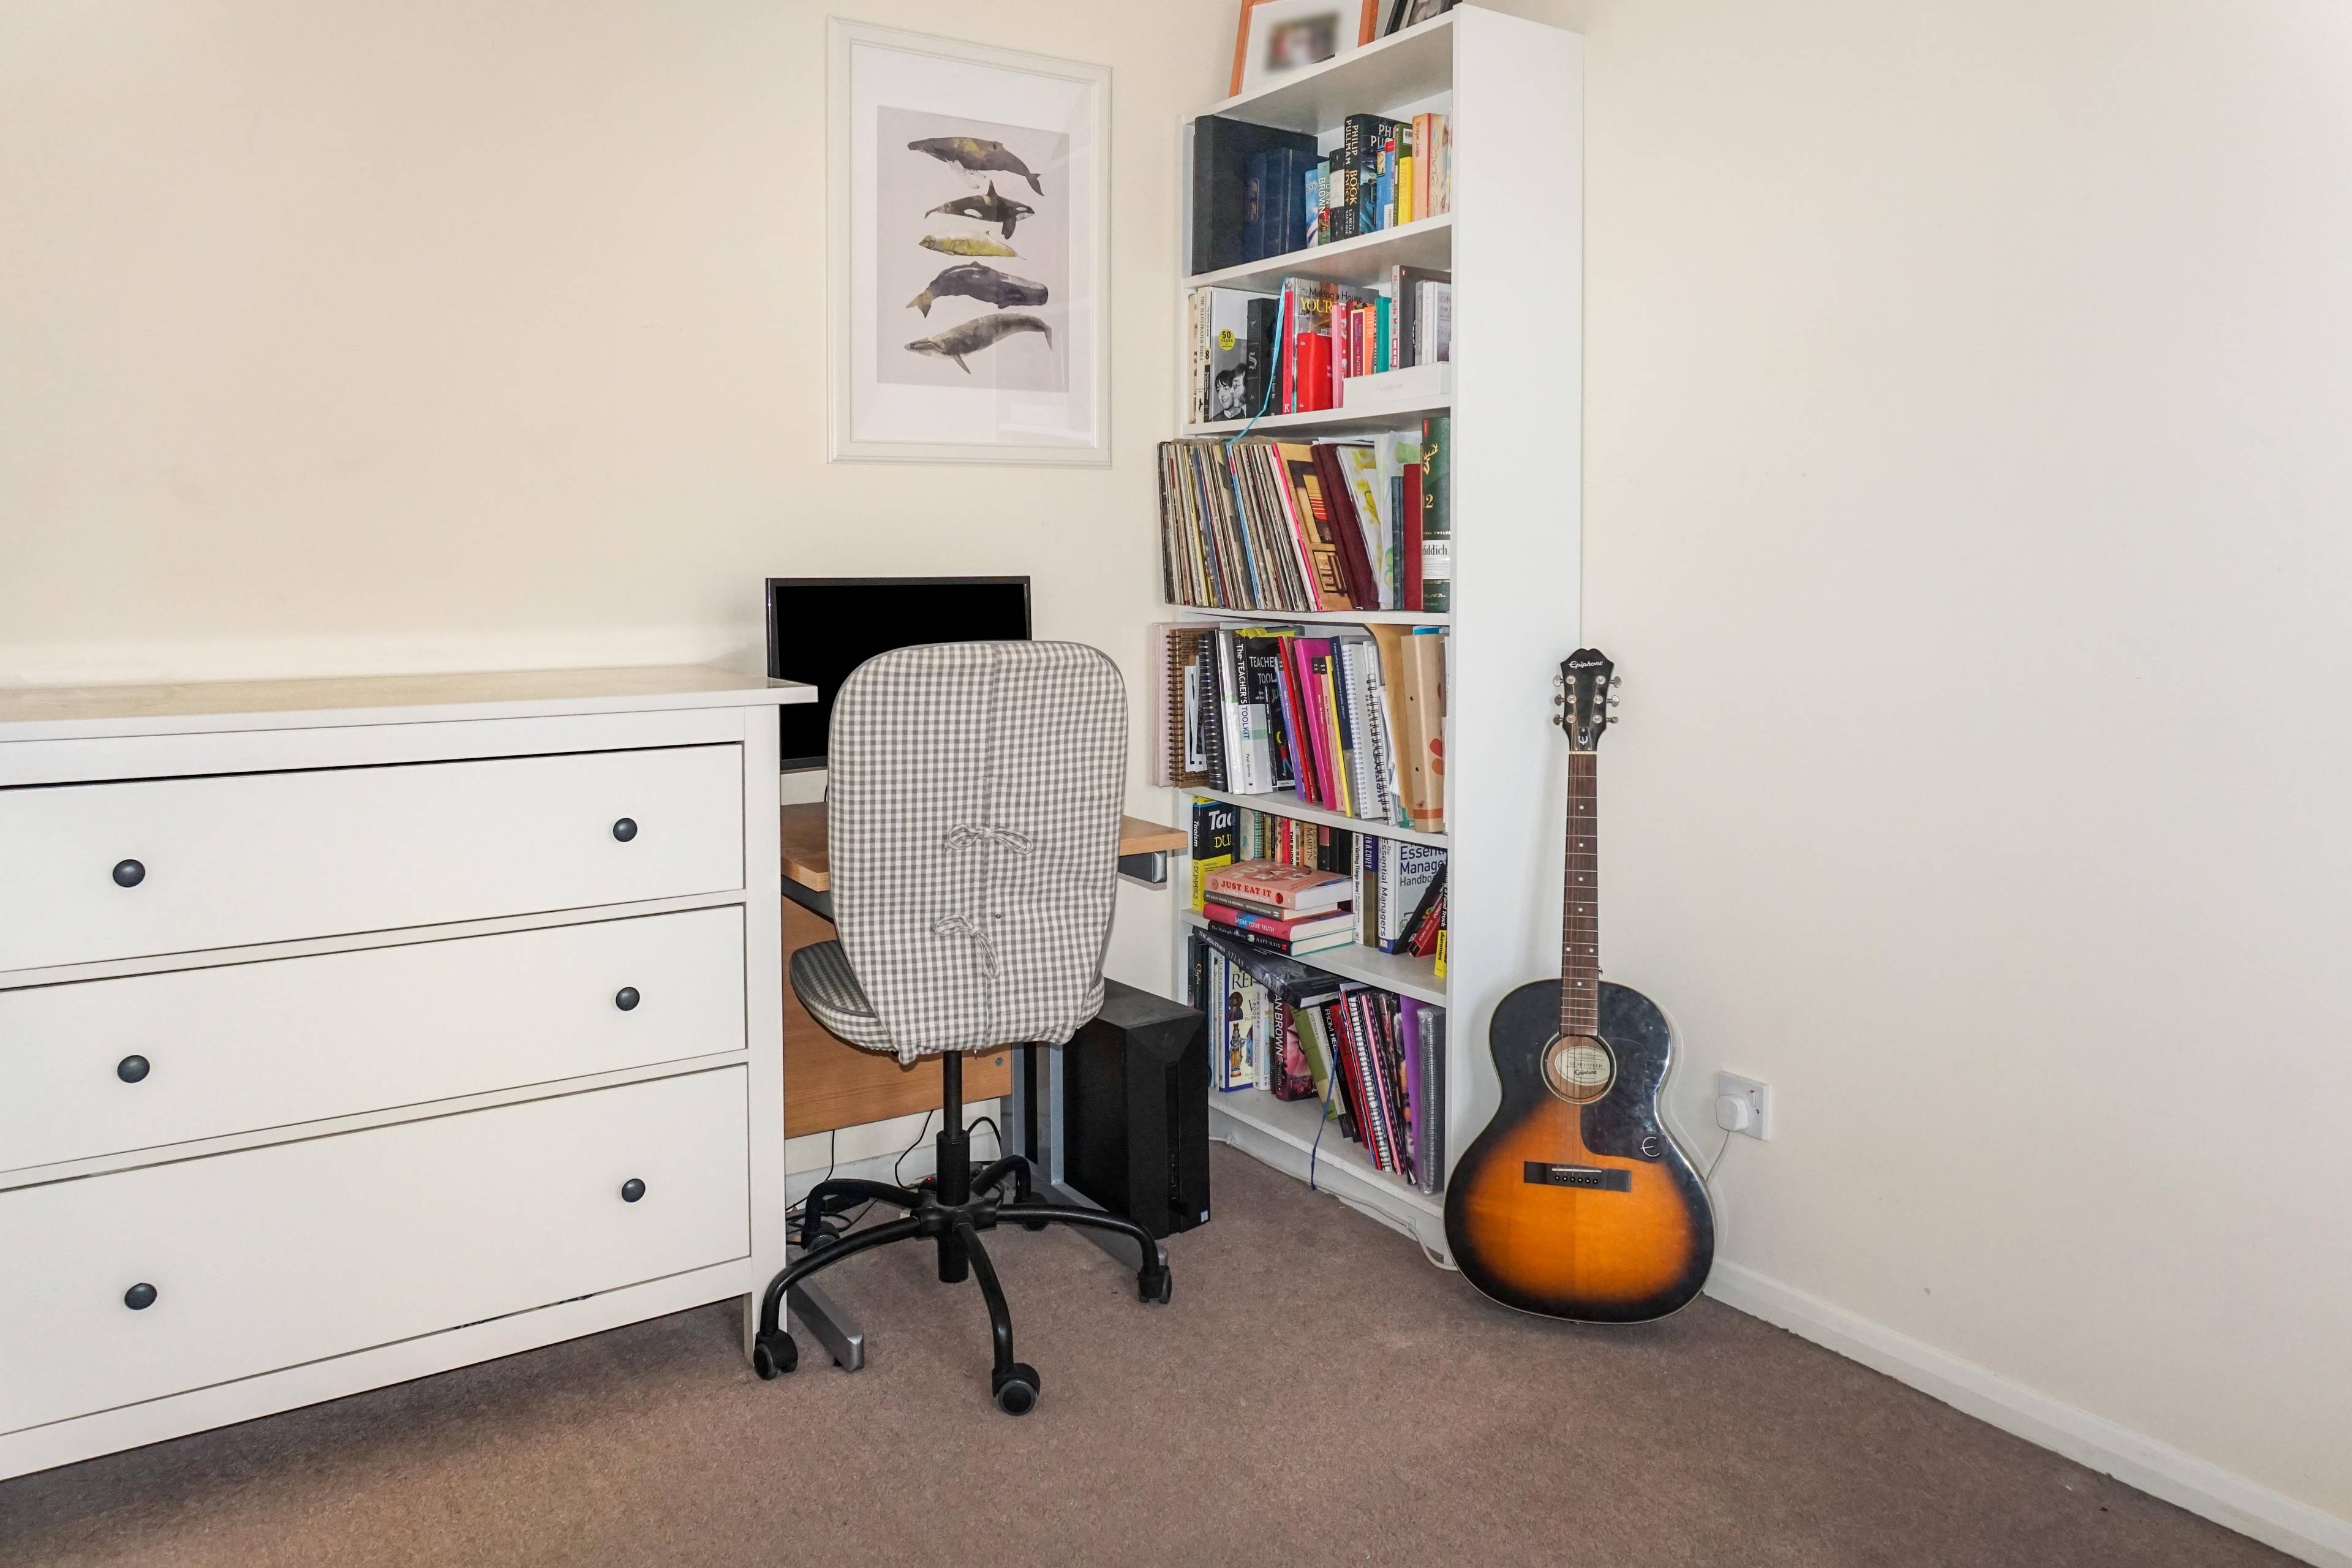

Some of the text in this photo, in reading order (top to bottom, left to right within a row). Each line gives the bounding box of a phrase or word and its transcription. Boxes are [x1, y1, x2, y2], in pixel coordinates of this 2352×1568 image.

[1349, 169, 1358, 206] BOOK
[1310, 287, 1334, 301] Making
[1341, 291, 1363, 303] House
[1299, 296, 1333, 313] YOUR
[1205, 350, 1210, 360] 8
[1284, 404, 1289, 413] K
[1249, 656, 1277, 668] TEACHE
[1568, 660, 1604, 669] Epiphone
[1257, 673, 1276, 684] TOOL
[1240, 706, 1251, 741] TOOLKIT
[1221, 881, 1272, 897] JUST EAT IT
[1240, 892, 1259, 901] THOMAS
[1235, 917, 1275, 933] SPEAK YOUR TRUTH
[1226, 951, 1244, 968] ATLAS
[1274, 993, 1283, 1056] AN BROWN
[1324, 1008, 1333, 1031] FROM
